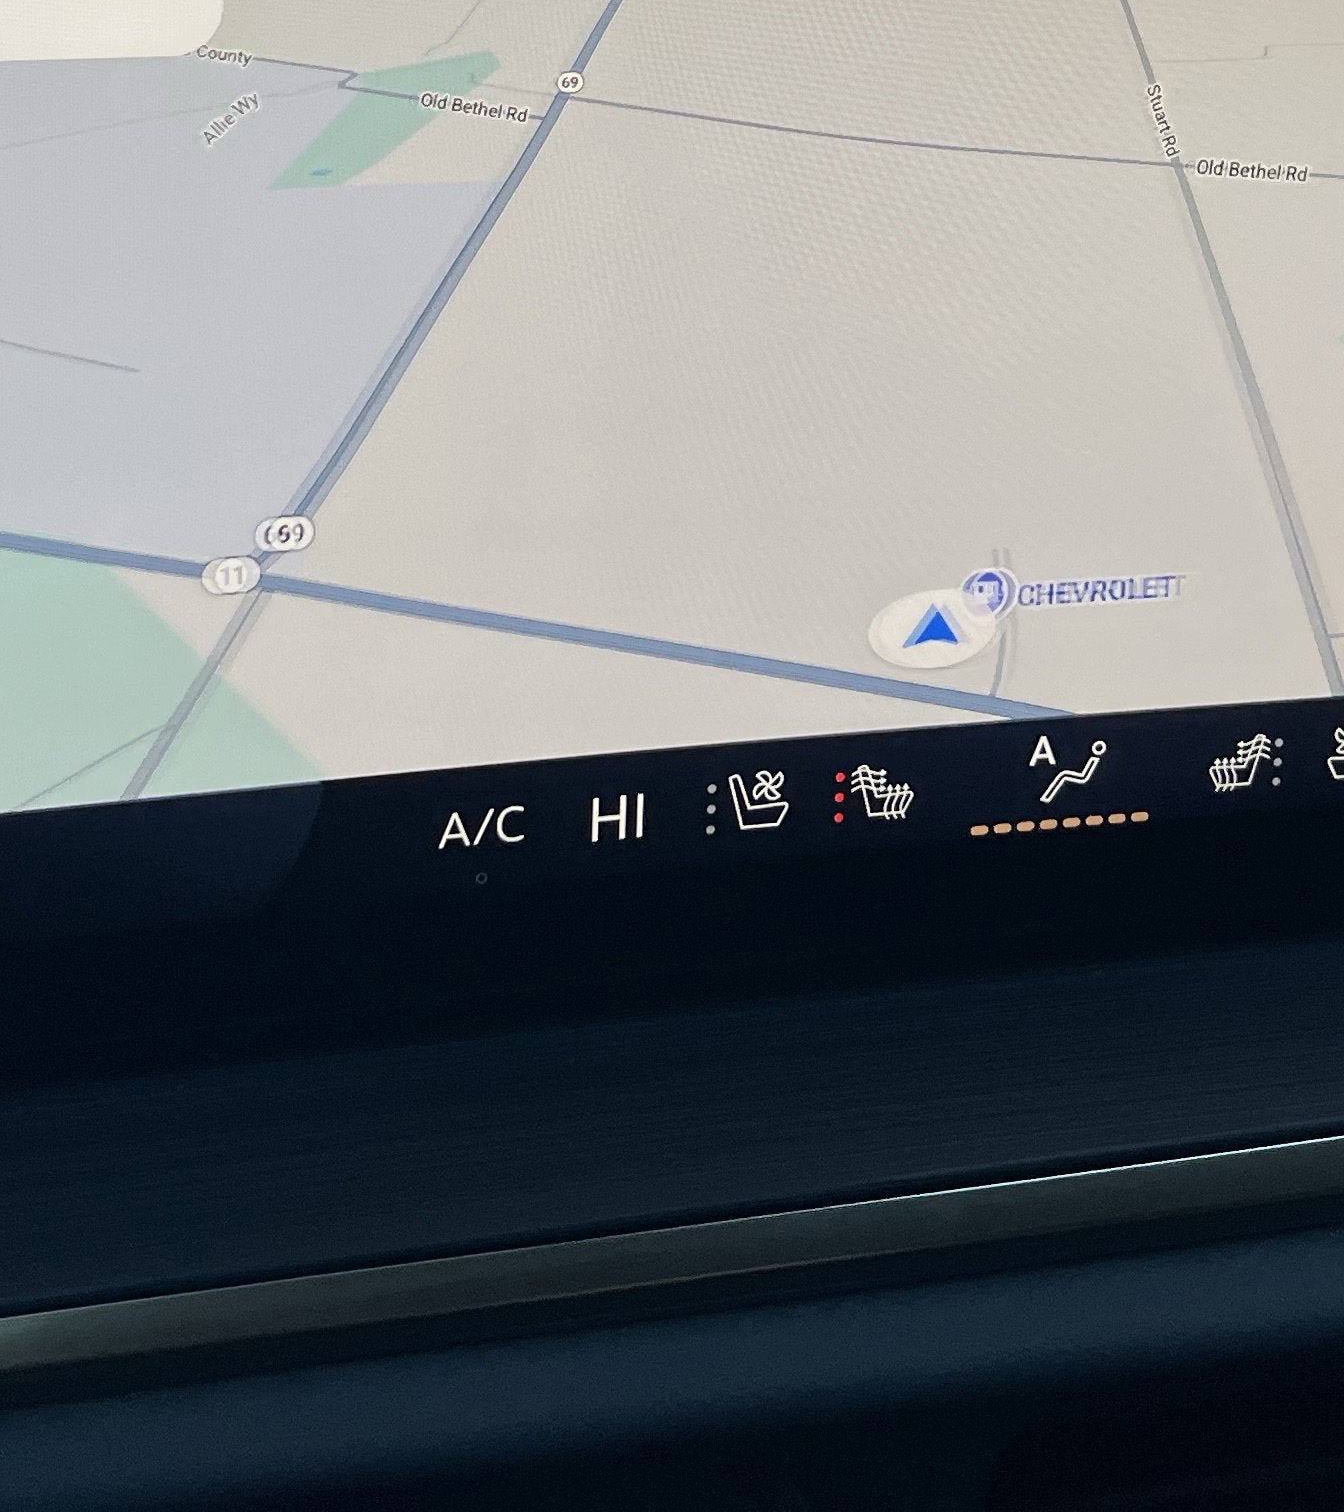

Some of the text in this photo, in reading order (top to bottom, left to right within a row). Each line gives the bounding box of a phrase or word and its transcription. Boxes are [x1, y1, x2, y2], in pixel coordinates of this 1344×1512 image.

[196, 45, 253, 67] County
[561, 76, 579, 89] 69
[204, 92, 260, 145] Allie Wy
[421, 92, 528, 123] Old Bethel Rd
[1148, 84, 1181, 157] Stuart Rd
[1197, 159, 1308, 182] Old Bethel Rd
[438, 804, 526, 851] A/C
[590, 793, 646, 842] HI
